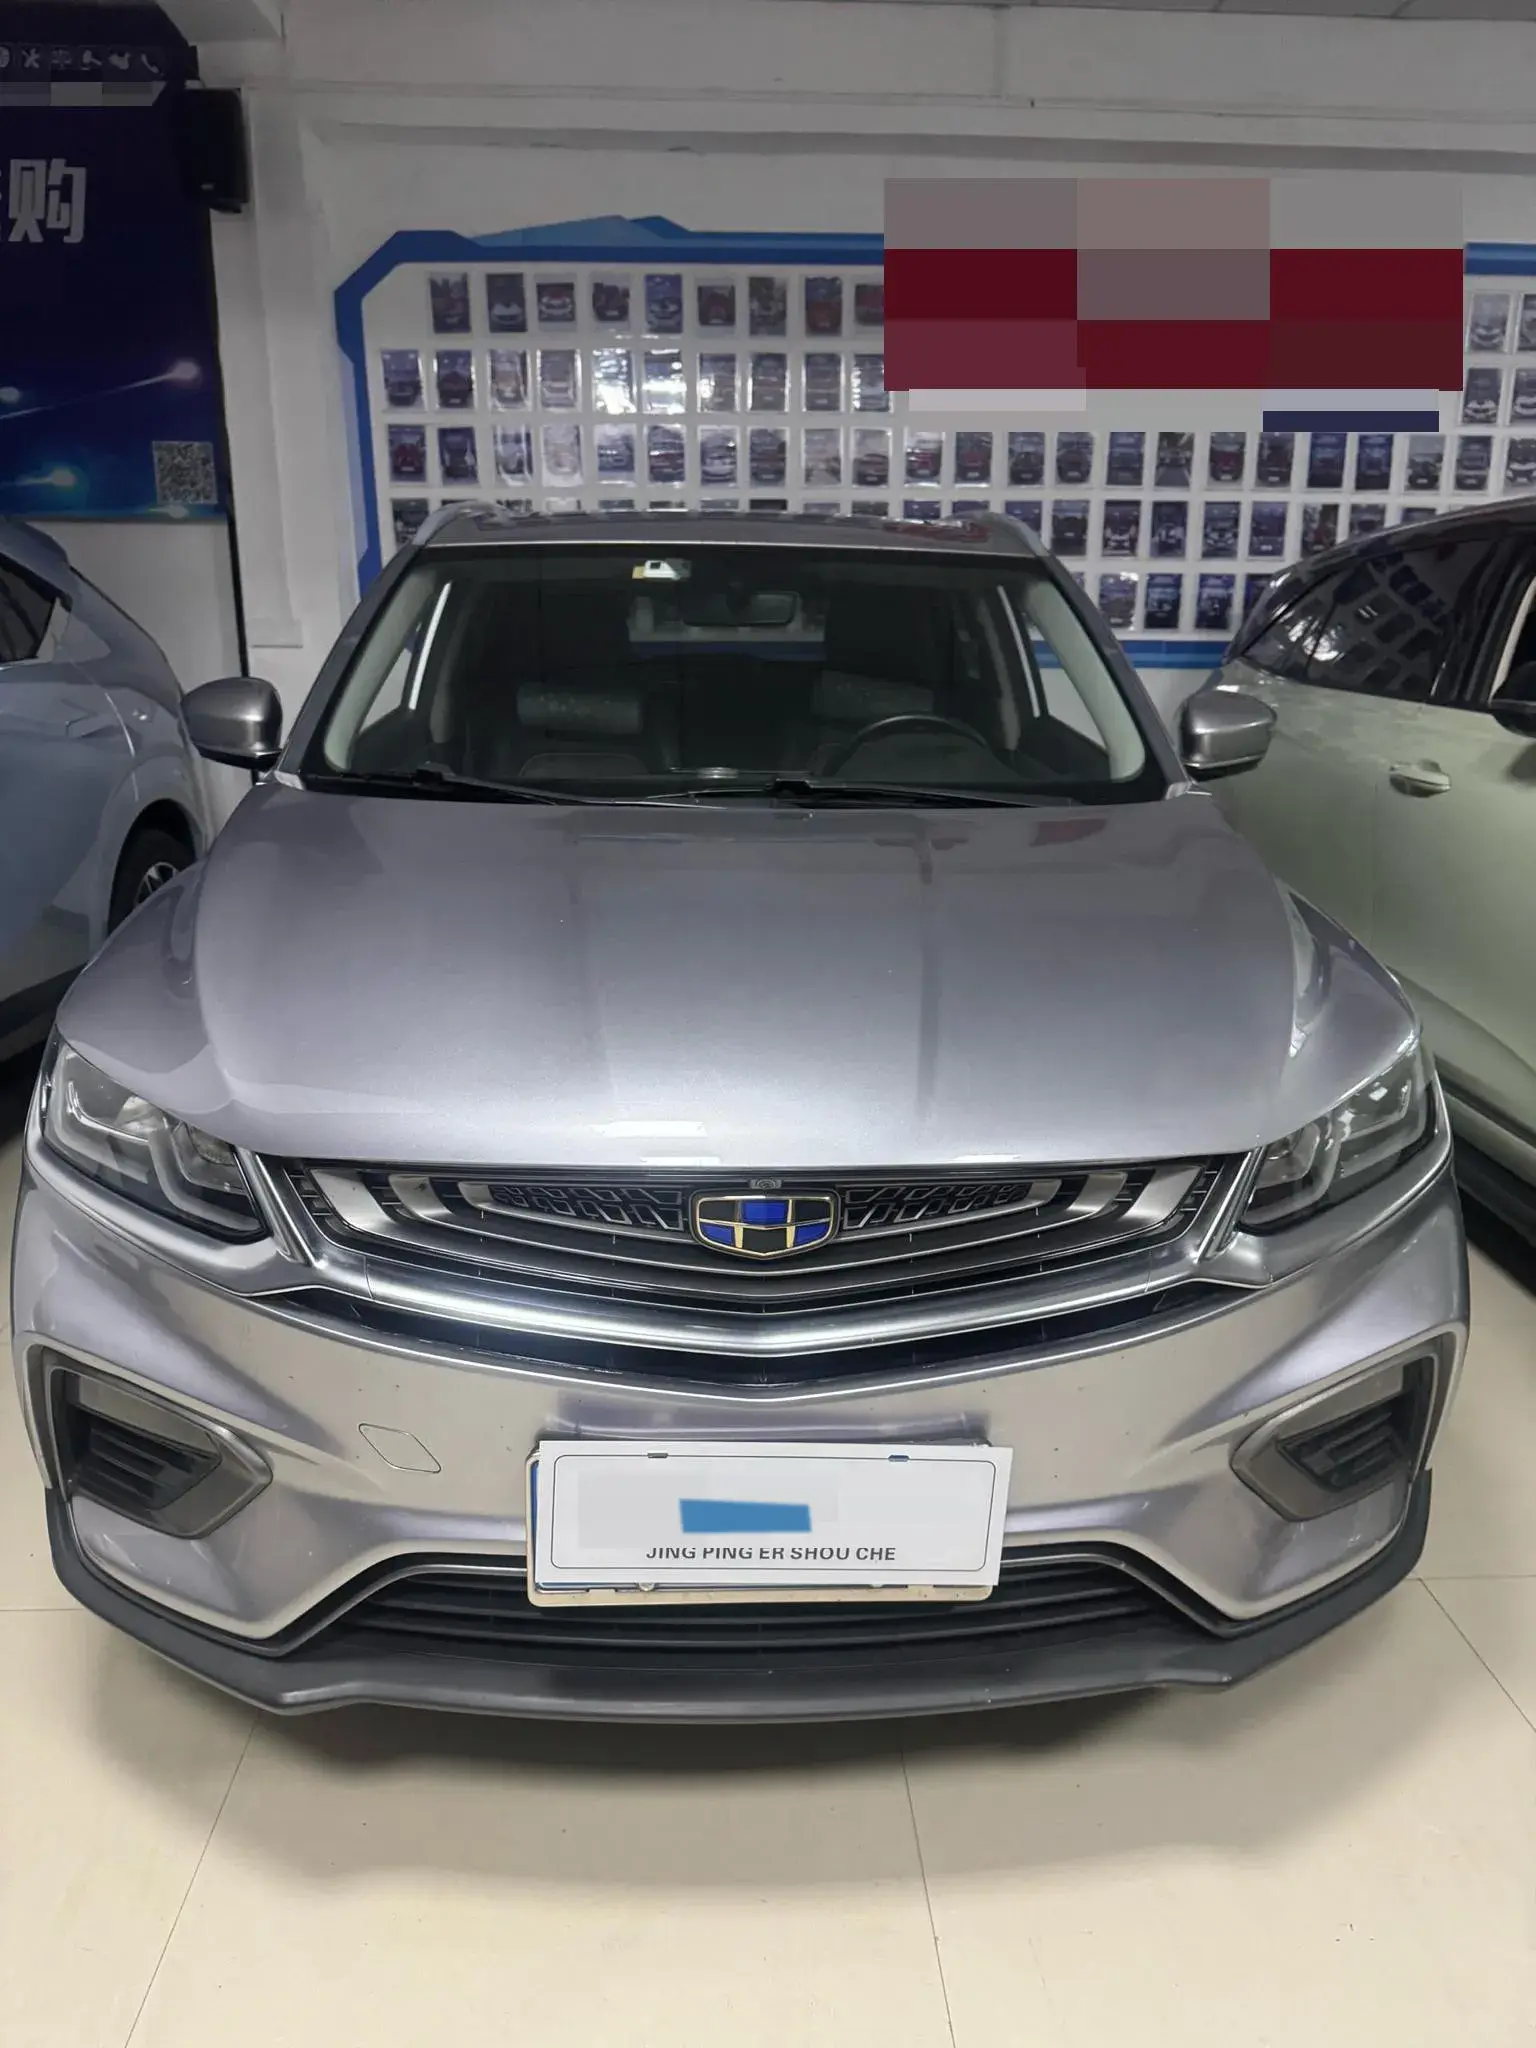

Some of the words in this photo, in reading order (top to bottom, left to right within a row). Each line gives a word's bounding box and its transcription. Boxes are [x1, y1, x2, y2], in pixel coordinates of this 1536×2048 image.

[0, 158, 86, 243] 购
[646, 1547, 695, 1560] JING
[703, 1547, 752, 1560] PING
[759, 1547, 785, 1560] ER
[790, 1547, 850, 1560] SHOU
[855, 1547, 896, 1560] CHE
